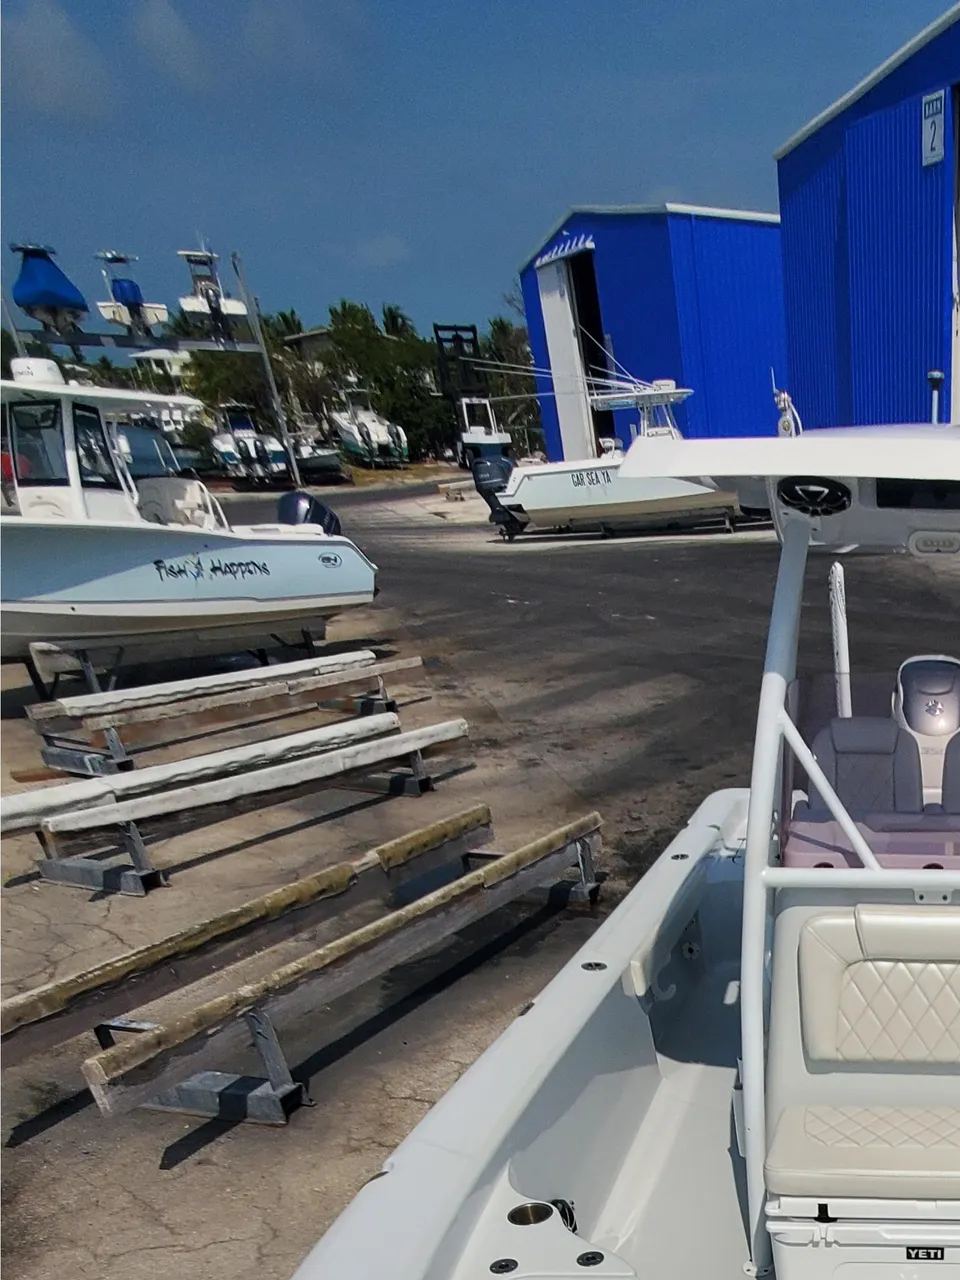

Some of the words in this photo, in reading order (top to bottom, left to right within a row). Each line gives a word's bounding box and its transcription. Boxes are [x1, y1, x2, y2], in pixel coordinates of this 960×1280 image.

[930, 120, 936, 152] 2
[586, 471, 601, 486] SEA
[601, 470, 612, 484] YA
[908, 1249, 941, 1258] YETI
